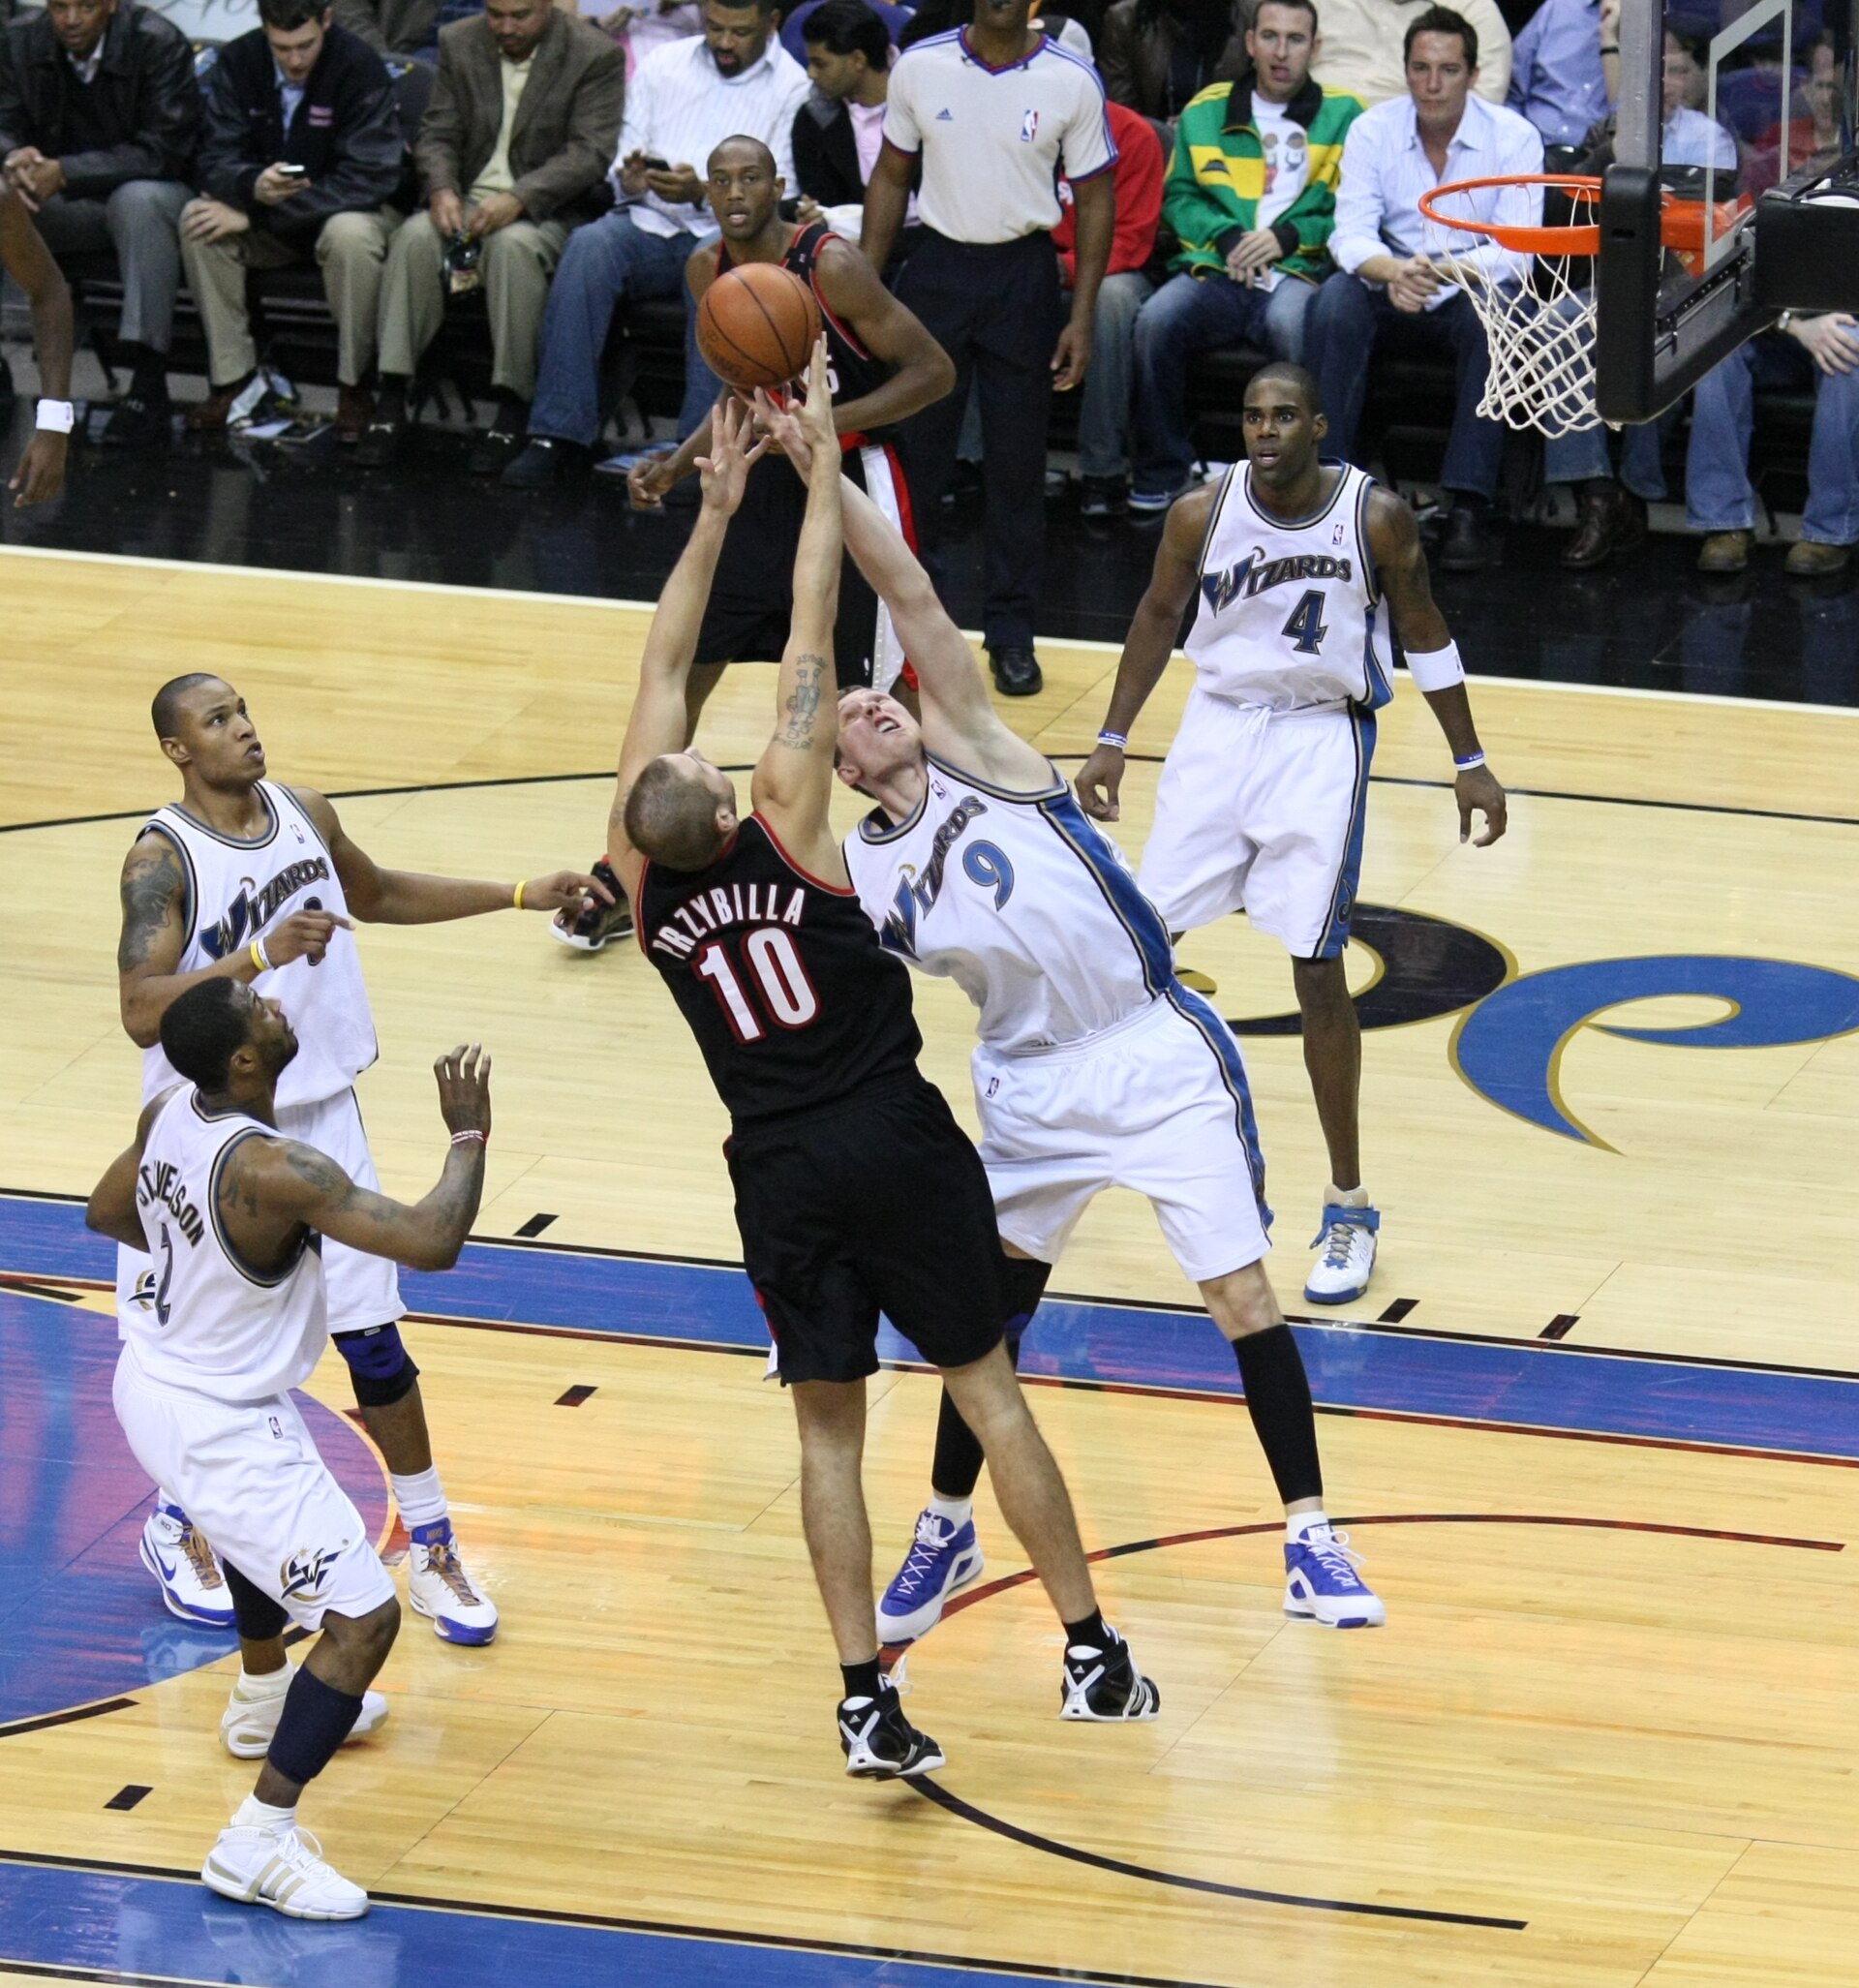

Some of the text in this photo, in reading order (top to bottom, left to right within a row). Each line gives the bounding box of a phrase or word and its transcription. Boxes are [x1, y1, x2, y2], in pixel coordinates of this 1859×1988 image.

[1200, 548, 1353, 618] WIZARDS
[1281, 589, 1328, 656] 4
[199, 856, 330, 962] WIZARDS
[879, 795, 989, 962] WIZARDS
[962, 839, 1015, 912] 9
[691, 926, 822, 1047] 10
